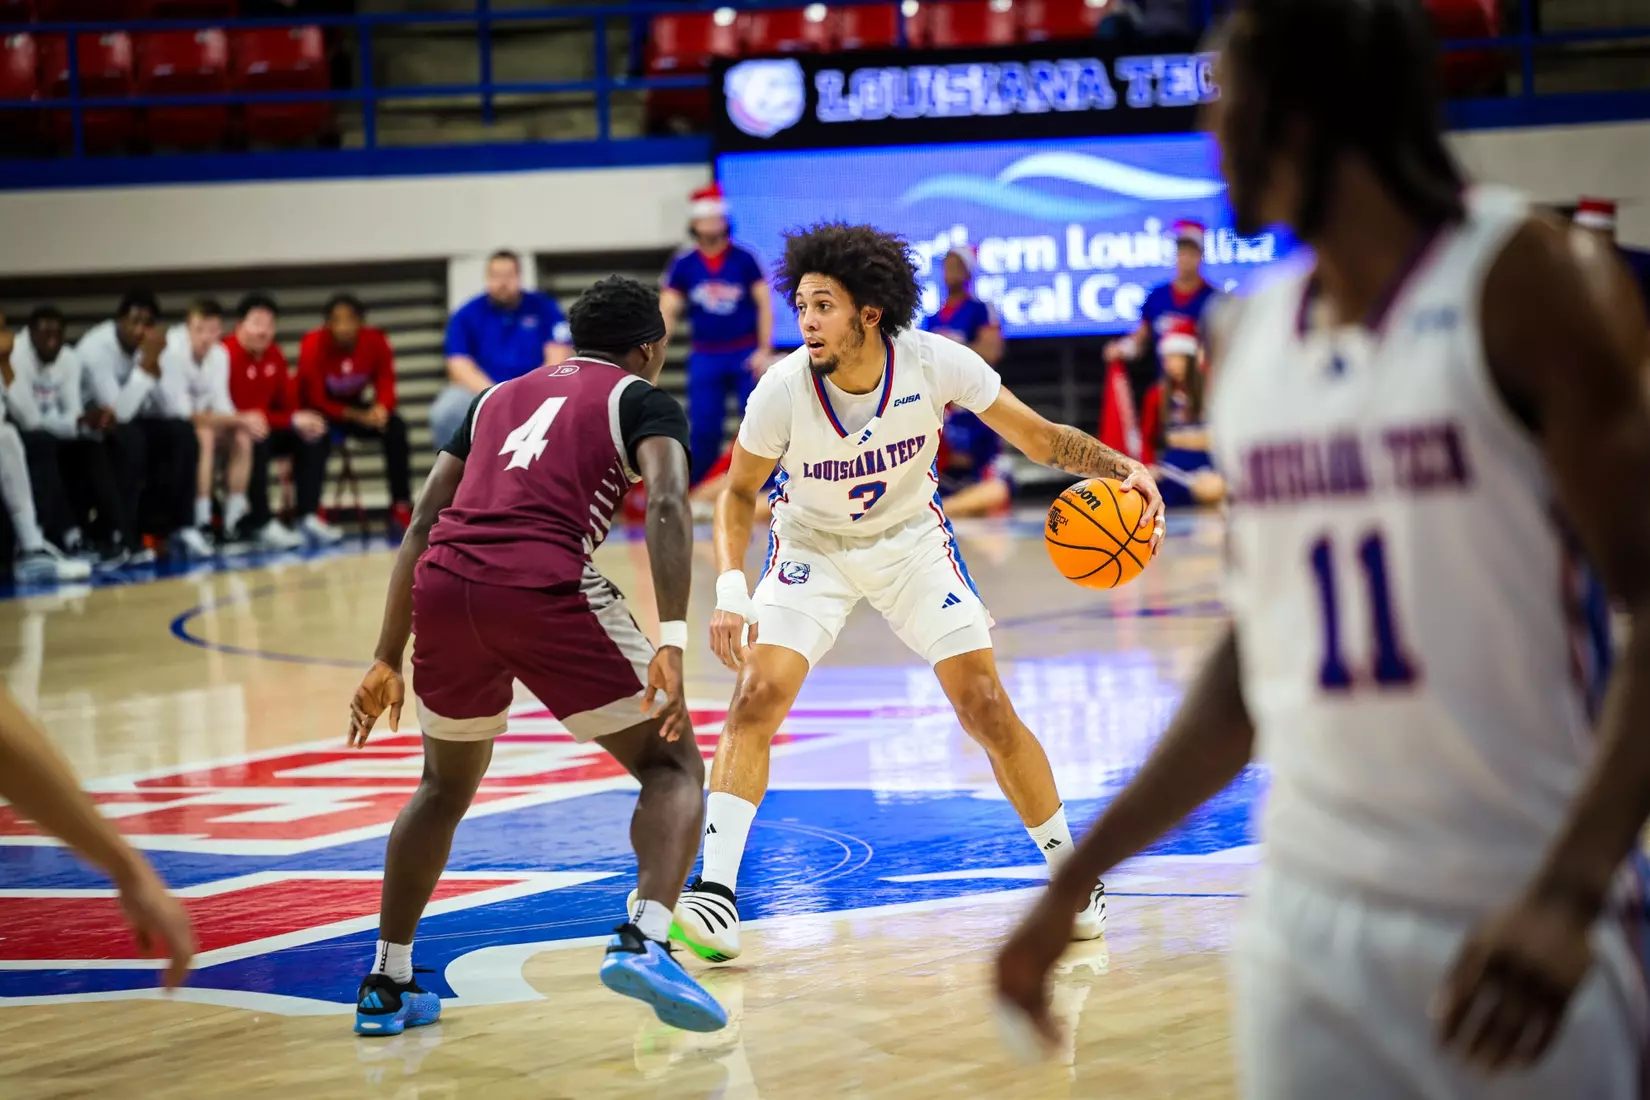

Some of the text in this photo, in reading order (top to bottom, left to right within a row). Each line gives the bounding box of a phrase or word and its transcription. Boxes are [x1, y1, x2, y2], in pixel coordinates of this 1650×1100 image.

[814, 51, 1222, 123] LOUISIANA TEC
[497, 396, 568, 471] 4
[803, 434, 926, 482] LOUISIANA TECH
[848, 480, 887, 522] 3
[1308, 526, 1424, 692] 11
